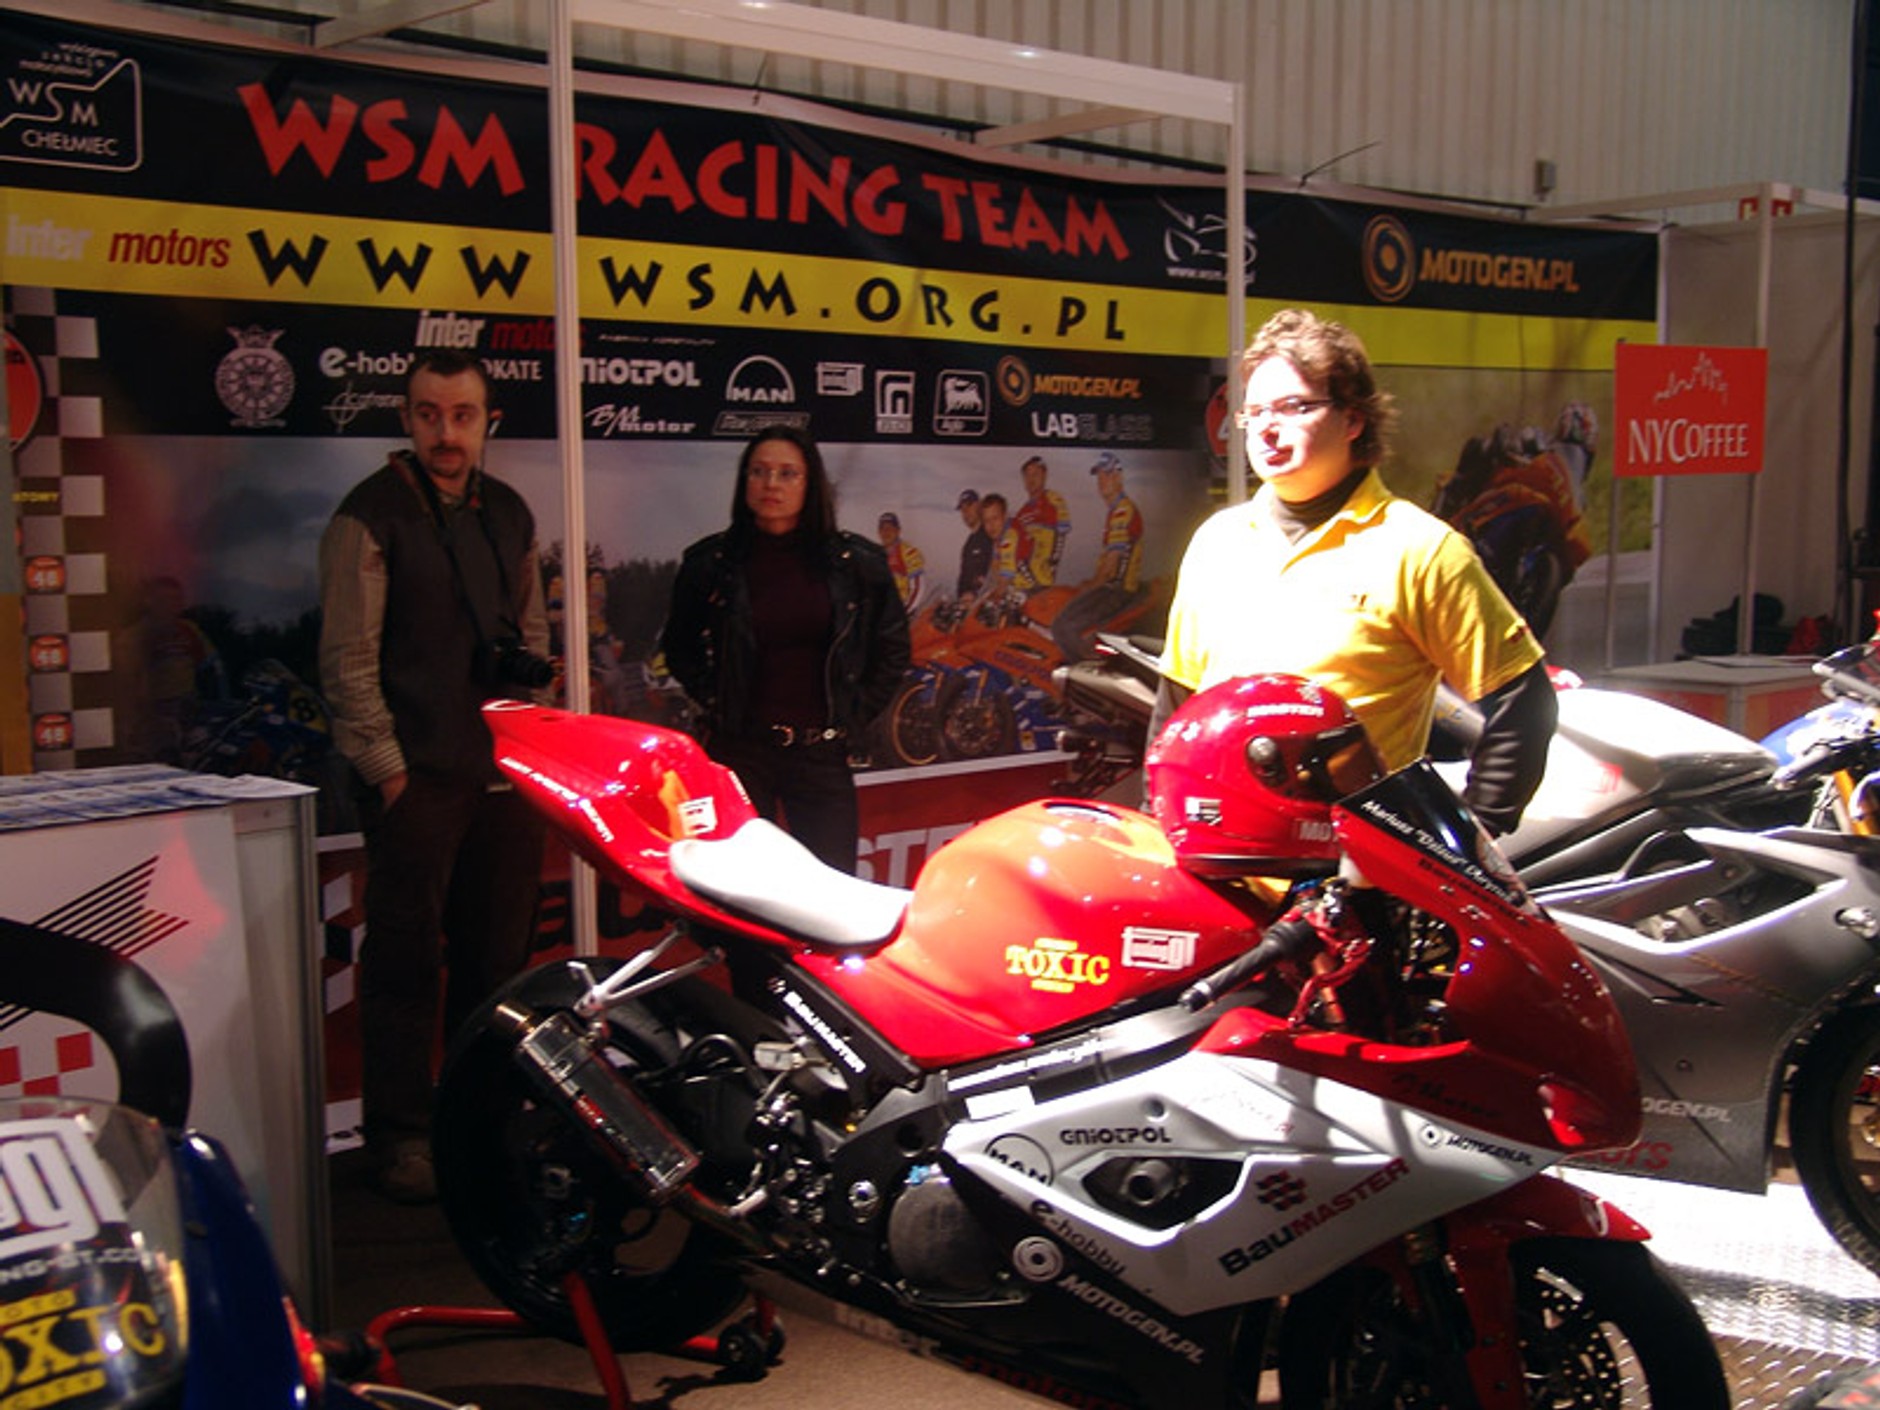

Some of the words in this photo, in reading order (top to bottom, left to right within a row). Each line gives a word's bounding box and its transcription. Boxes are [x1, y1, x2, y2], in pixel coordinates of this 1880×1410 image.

[236, 82, 526, 197] WSM
[574, 121, 907, 236] RACING
[921, 172, 1131, 261] TEAM
[108, 228, 231, 268] motors
[1418, 247, 1581, 294] MOTOGEN.PL
[415, 310, 487, 348] inter
[490, 319, 587, 352] moto
[732, 386, 789, 404] MAN
[1034, 373, 1143, 399] MOTOGEN.PL
[1005, 944, 1110, 985] TOXIC
[1056, 1273, 1205, 1365] MOTOGEN.PL
